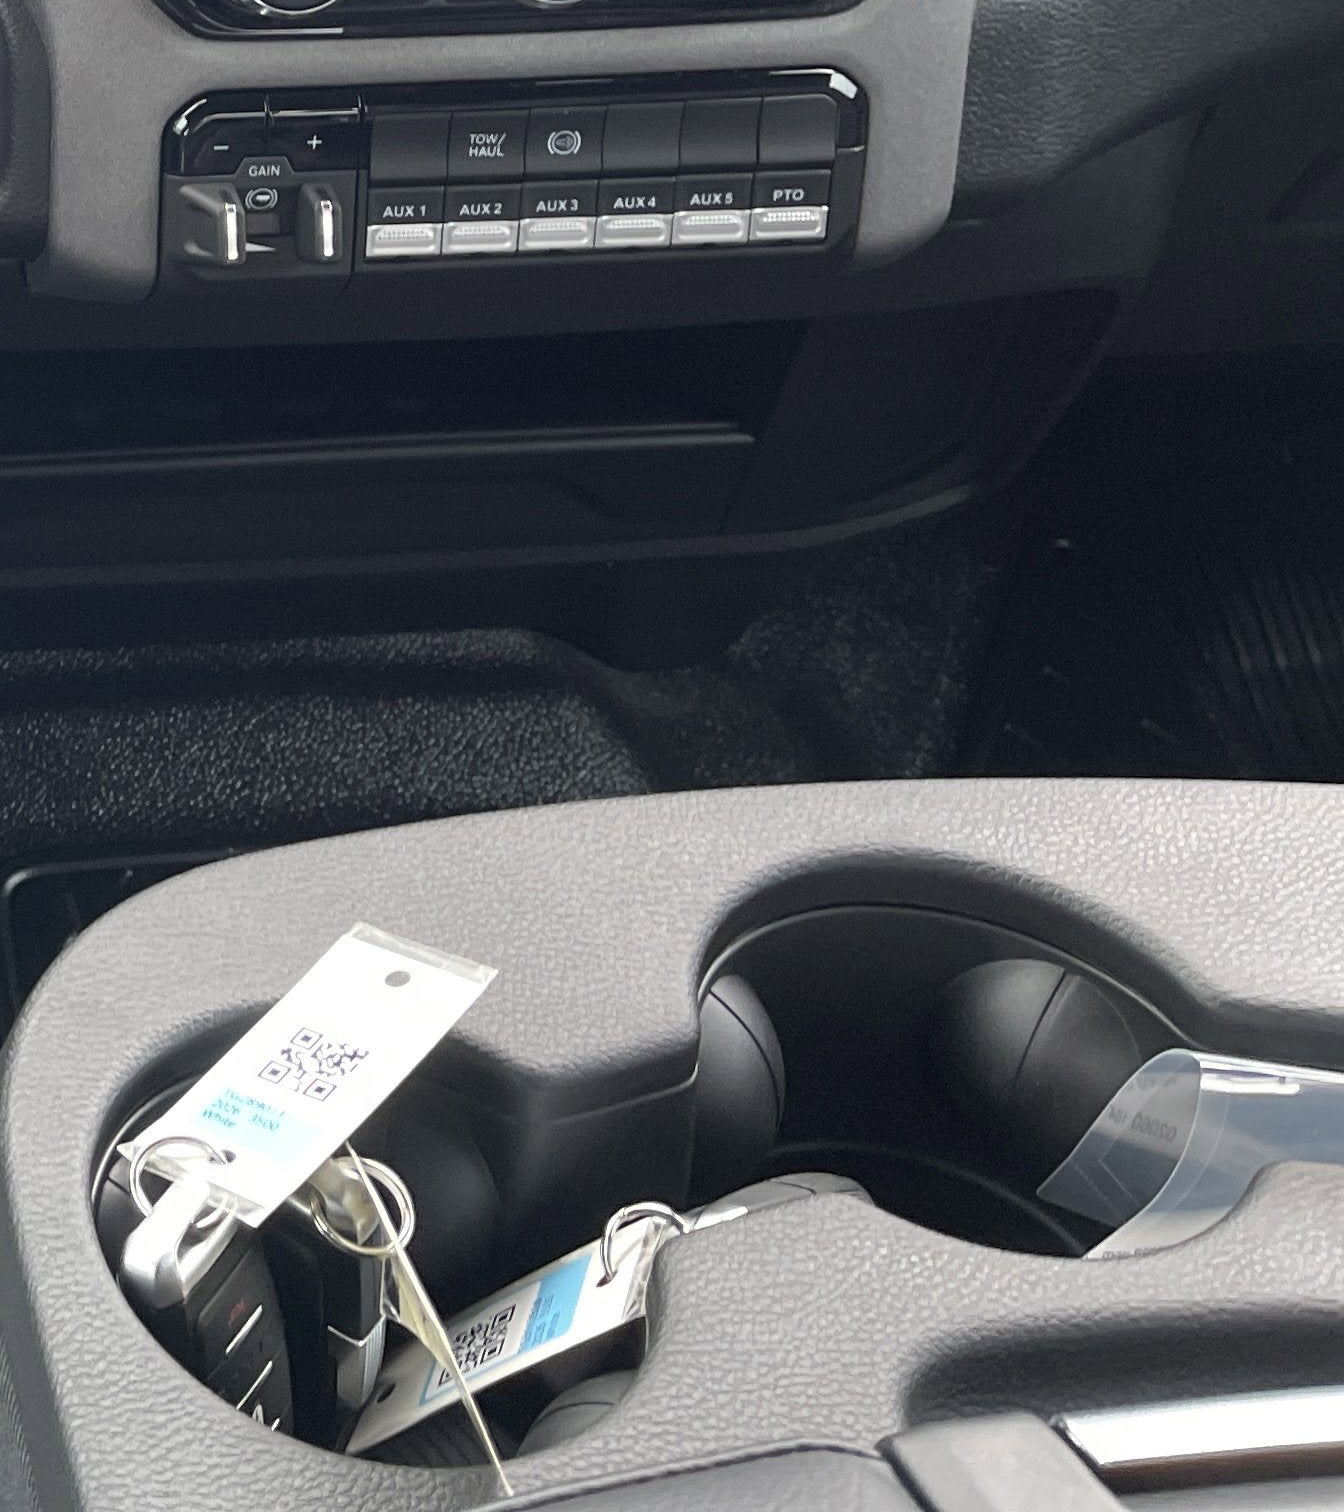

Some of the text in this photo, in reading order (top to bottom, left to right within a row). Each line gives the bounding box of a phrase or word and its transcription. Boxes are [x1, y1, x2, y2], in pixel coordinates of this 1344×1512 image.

[468, 132, 506, 149] TOW/
[468, 144, 505, 158] HAUL
[248, 165, 281, 177] GAIN
[689, 192, 733, 206] AUX 5
[772, 188, 805, 202] PTO
[459, 202, 503, 217] AUX 2
[535, 198, 579, 213] AUX 3
[613, 196, 657, 210] AUX 4
[382, 205, 427, 219] AUX 1
